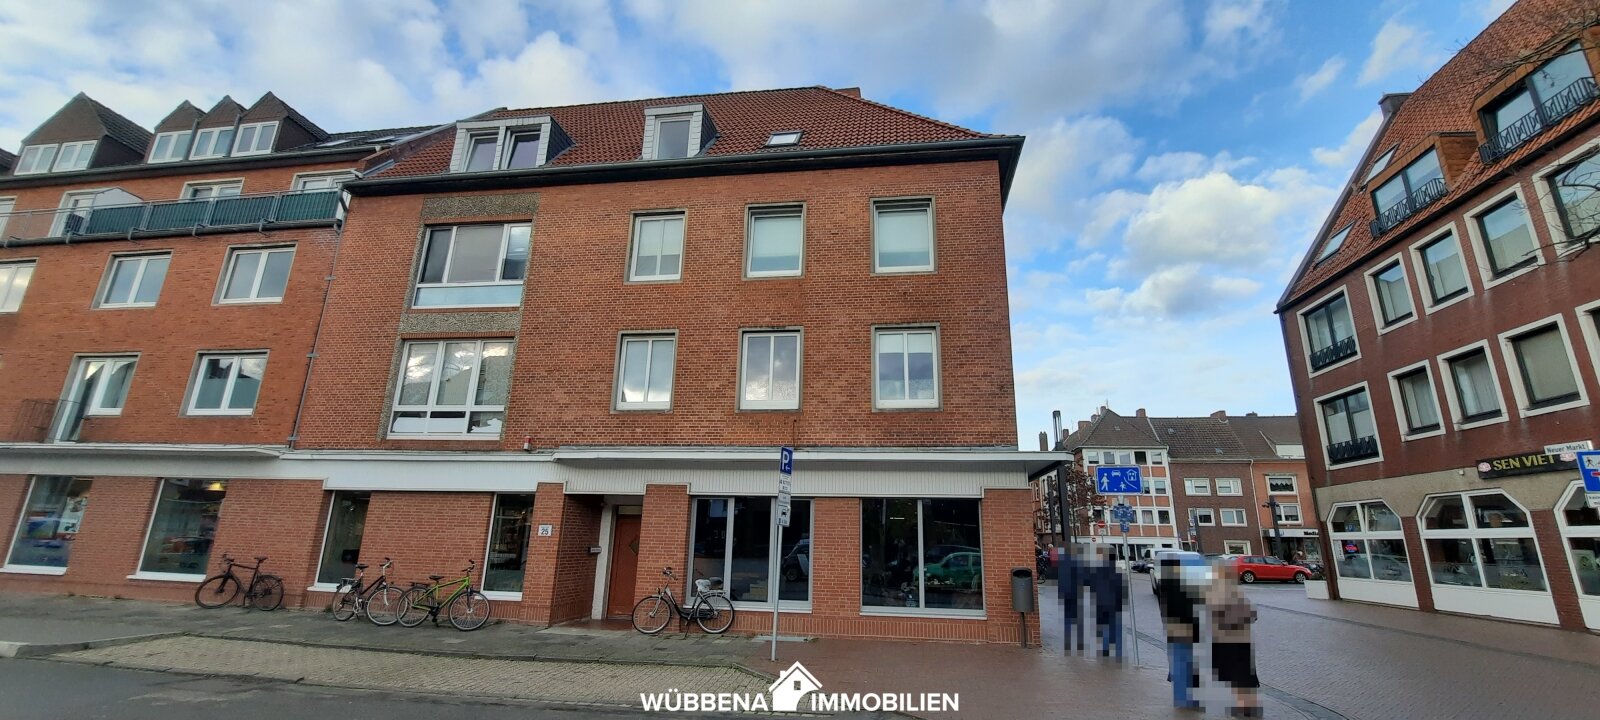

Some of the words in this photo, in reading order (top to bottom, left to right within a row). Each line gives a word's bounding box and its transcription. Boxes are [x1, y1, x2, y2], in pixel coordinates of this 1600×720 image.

[782, 451, 790, 470] P
[1492, 457, 1520, 471] SEN
[1521, 454, 1555, 467] VIET
